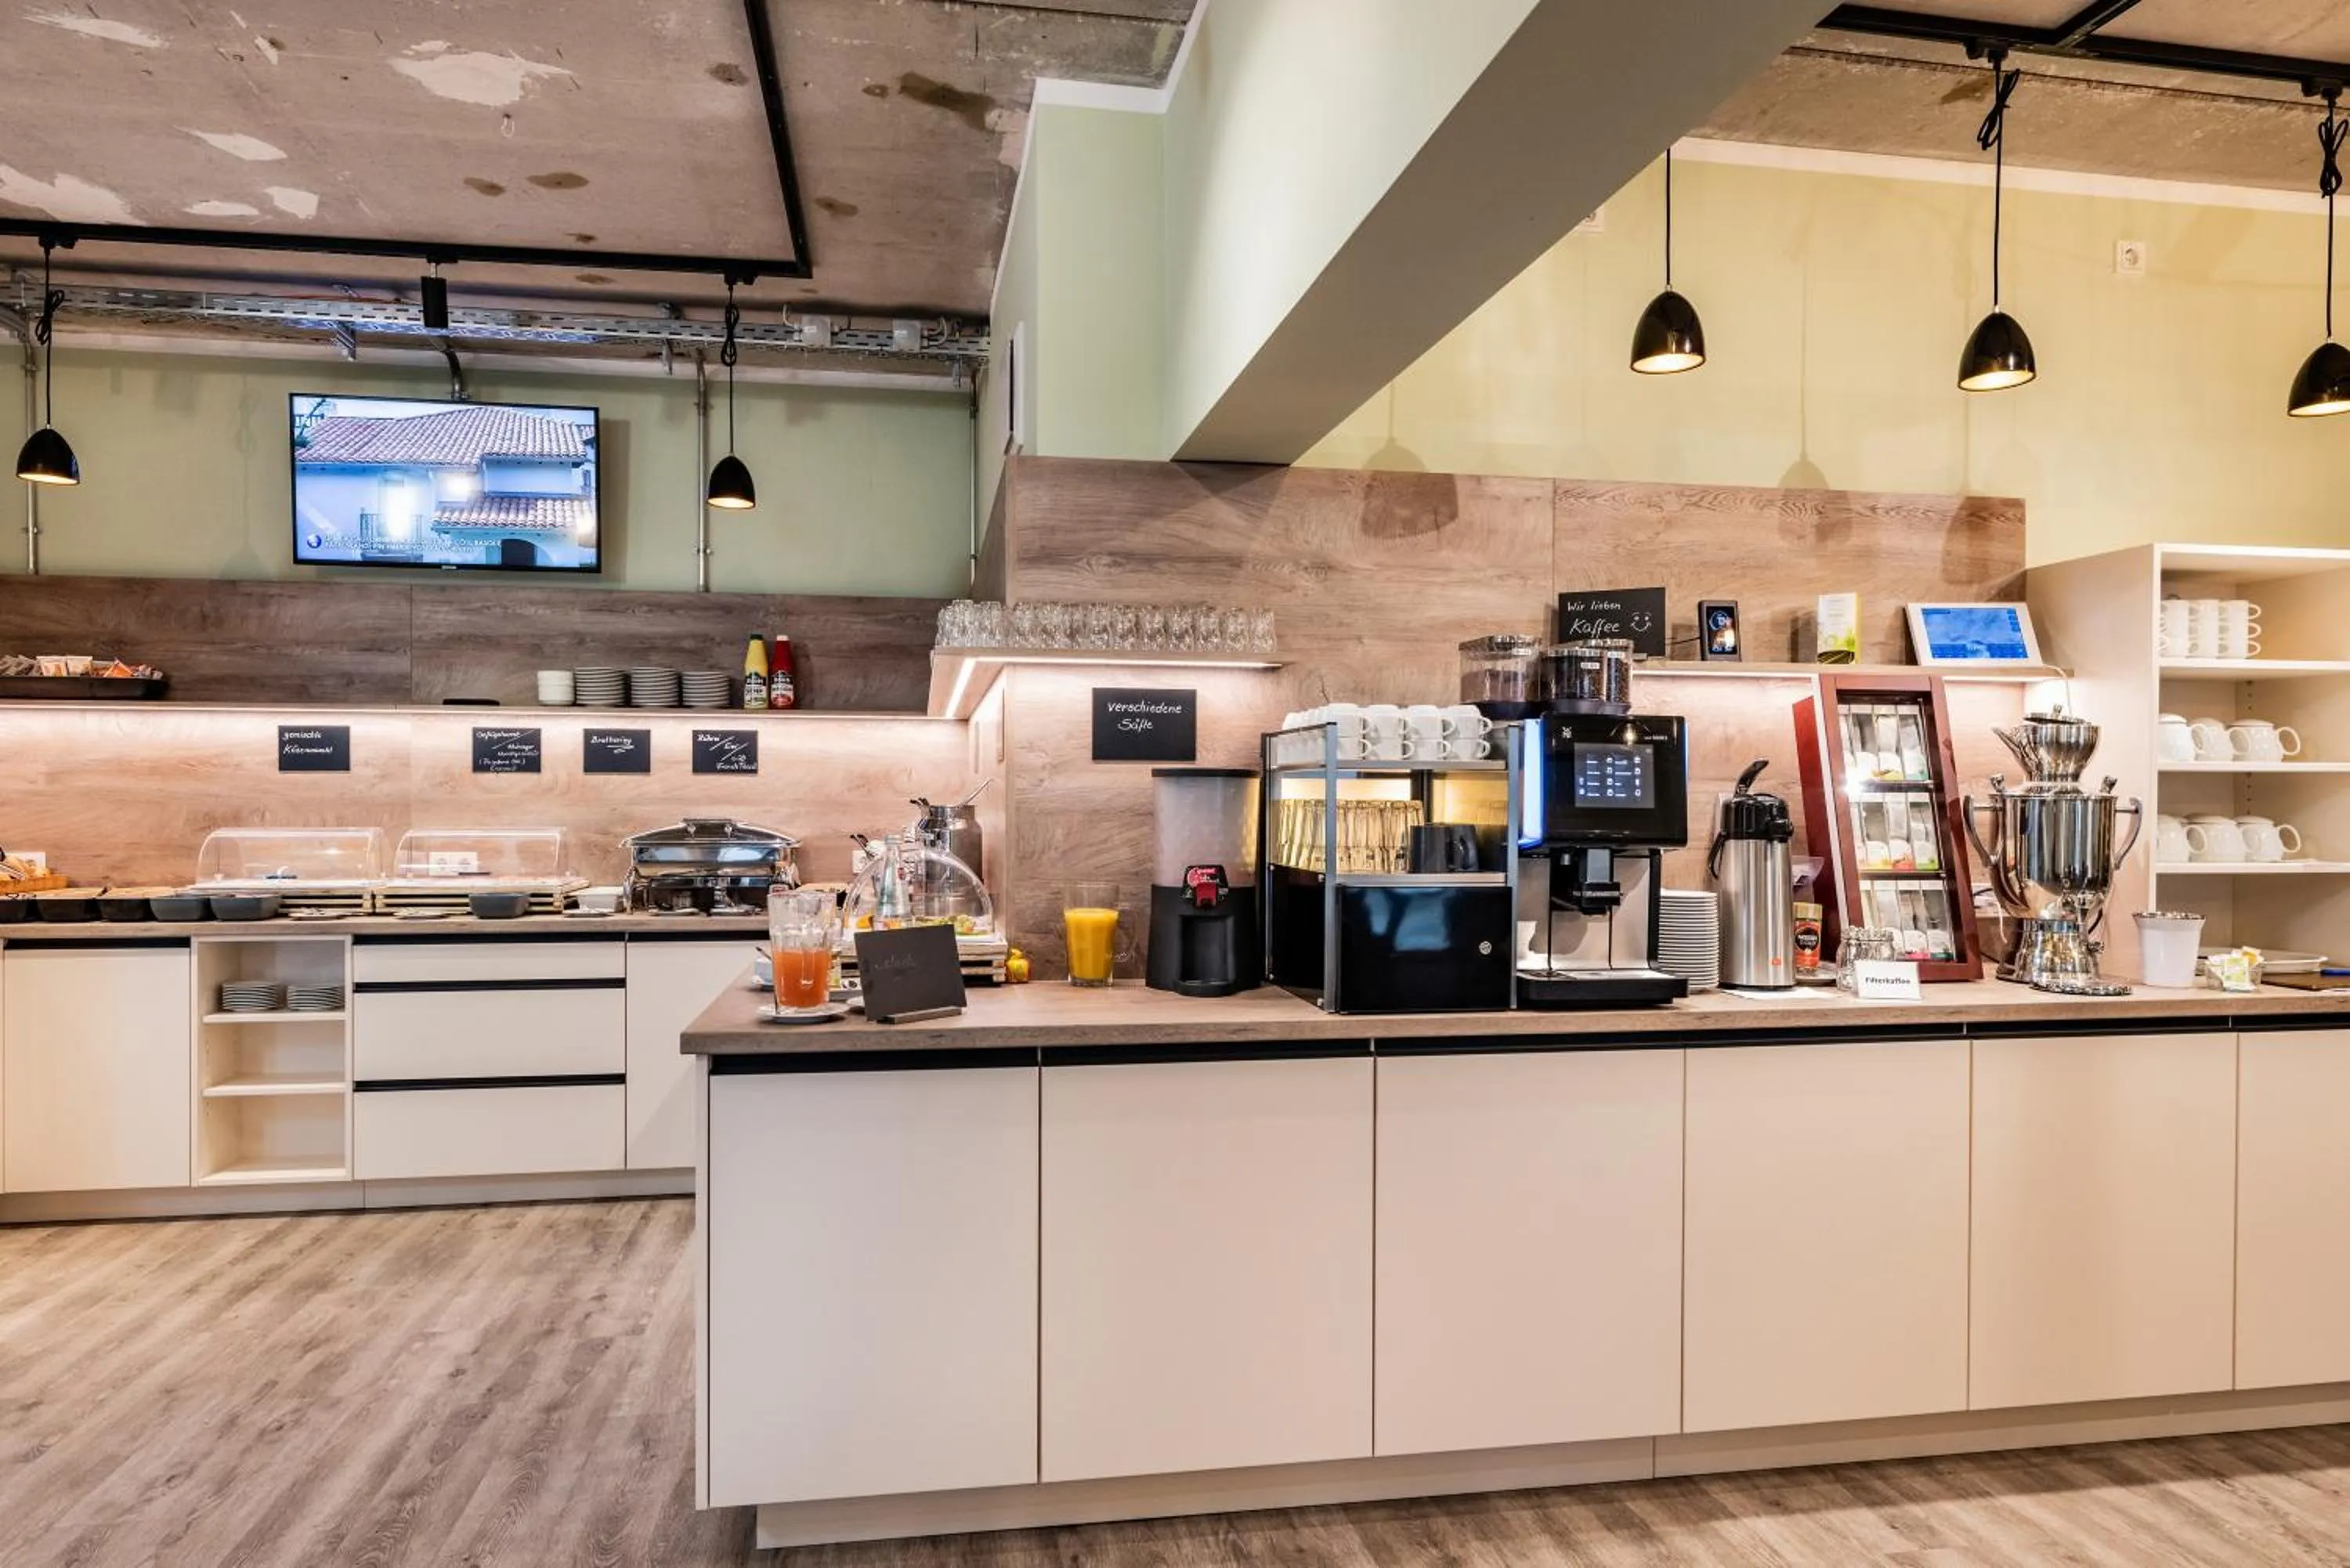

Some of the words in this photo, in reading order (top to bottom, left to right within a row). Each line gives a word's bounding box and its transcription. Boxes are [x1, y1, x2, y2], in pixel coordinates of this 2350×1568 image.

[1567, 601, 1585, 611] Wir
[1589, 601, 1621, 610] lieben
[1569, 618, 1621, 639] Kaffee
